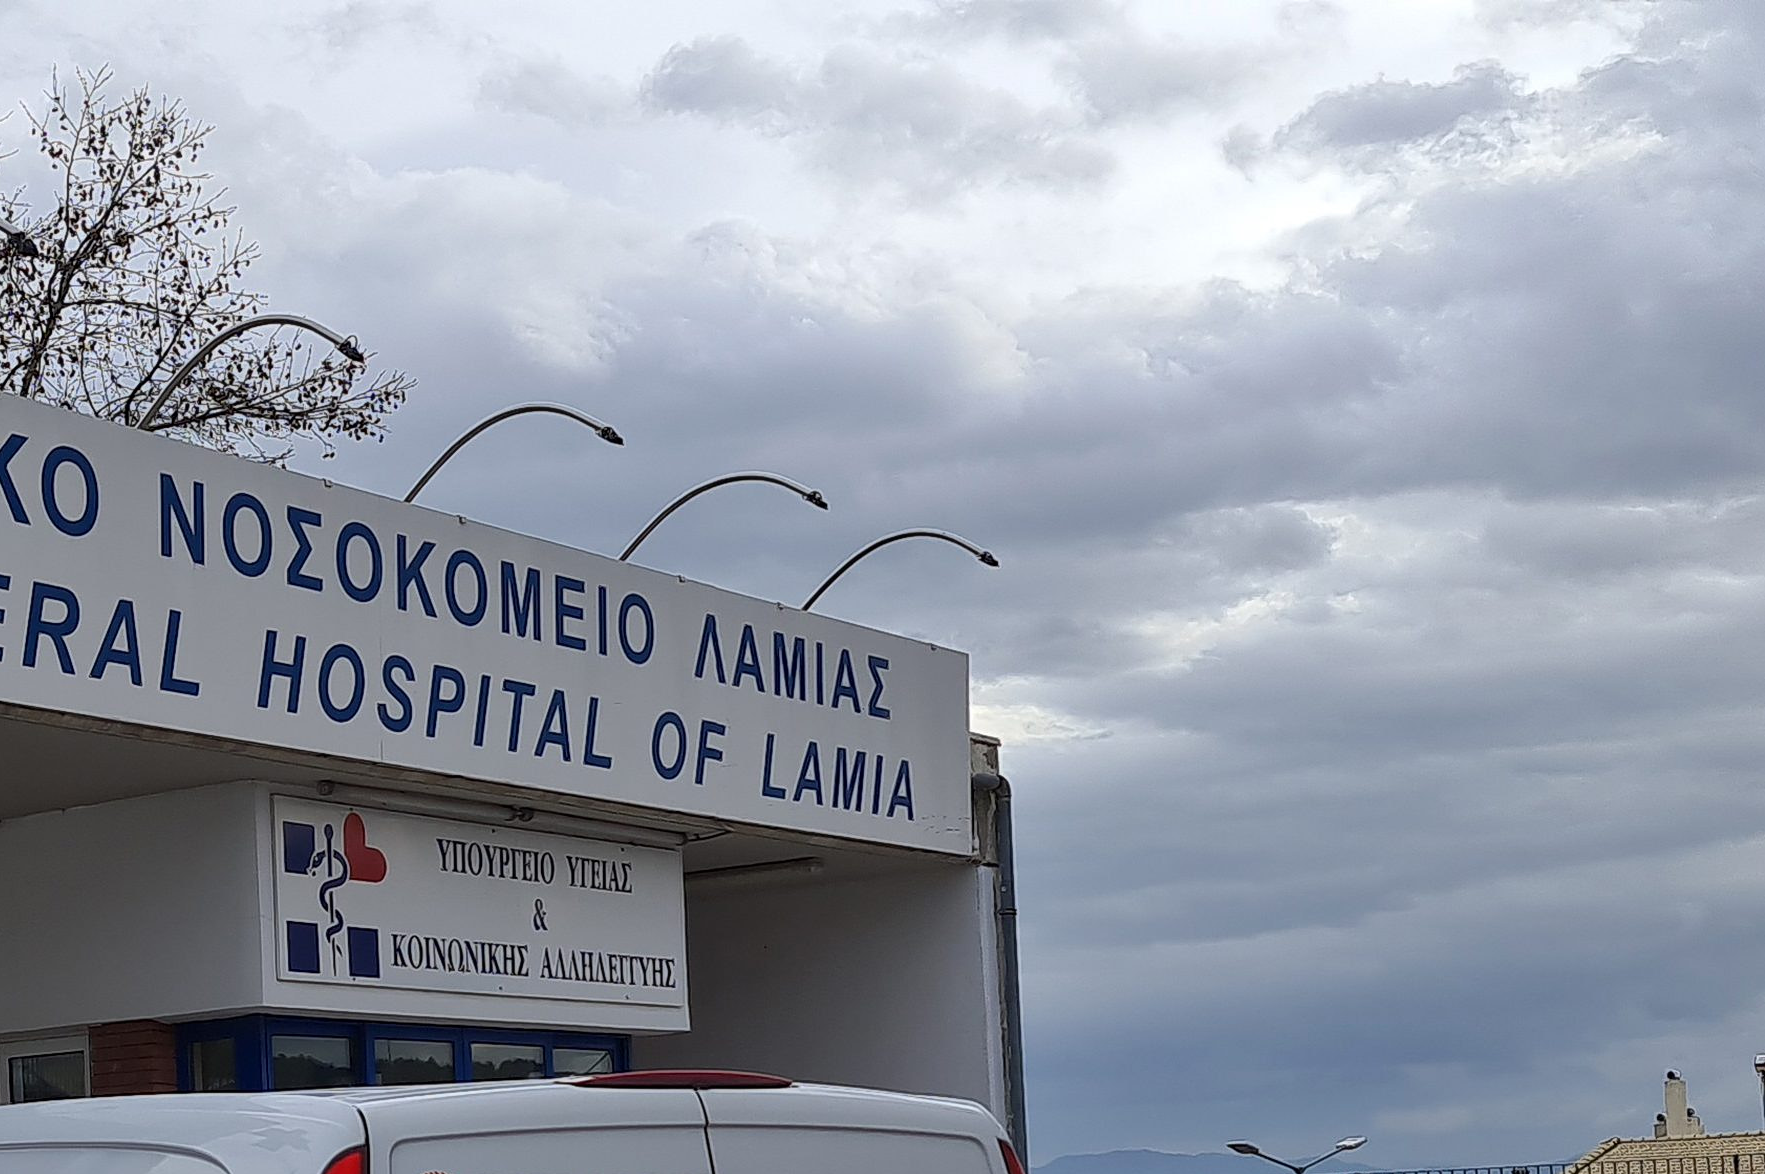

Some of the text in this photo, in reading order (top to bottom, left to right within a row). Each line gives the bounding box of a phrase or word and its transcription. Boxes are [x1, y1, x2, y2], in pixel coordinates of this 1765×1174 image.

[160, 472, 655, 666] ΝΟΣΟΚΟΜΕΙΟ
[695, 613, 892, 721] ΛΑΜΙΑΣ
[257, 628, 613, 769] HOSPITAL
[652, 709, 727, 785] OF
[762, 733, 917, 822] LAMIA
[436, 838, 632, 894] ΥΠΟΥΡΓΕΙΟ ΥΓΕΙΑΣ
[532, 898, 548, 932] &
[390, 933, 676, 989] ΚΟΙΝΩΝΙΚΗΣ ΑΛΛΗΛΕΓΓΥΗΣ
